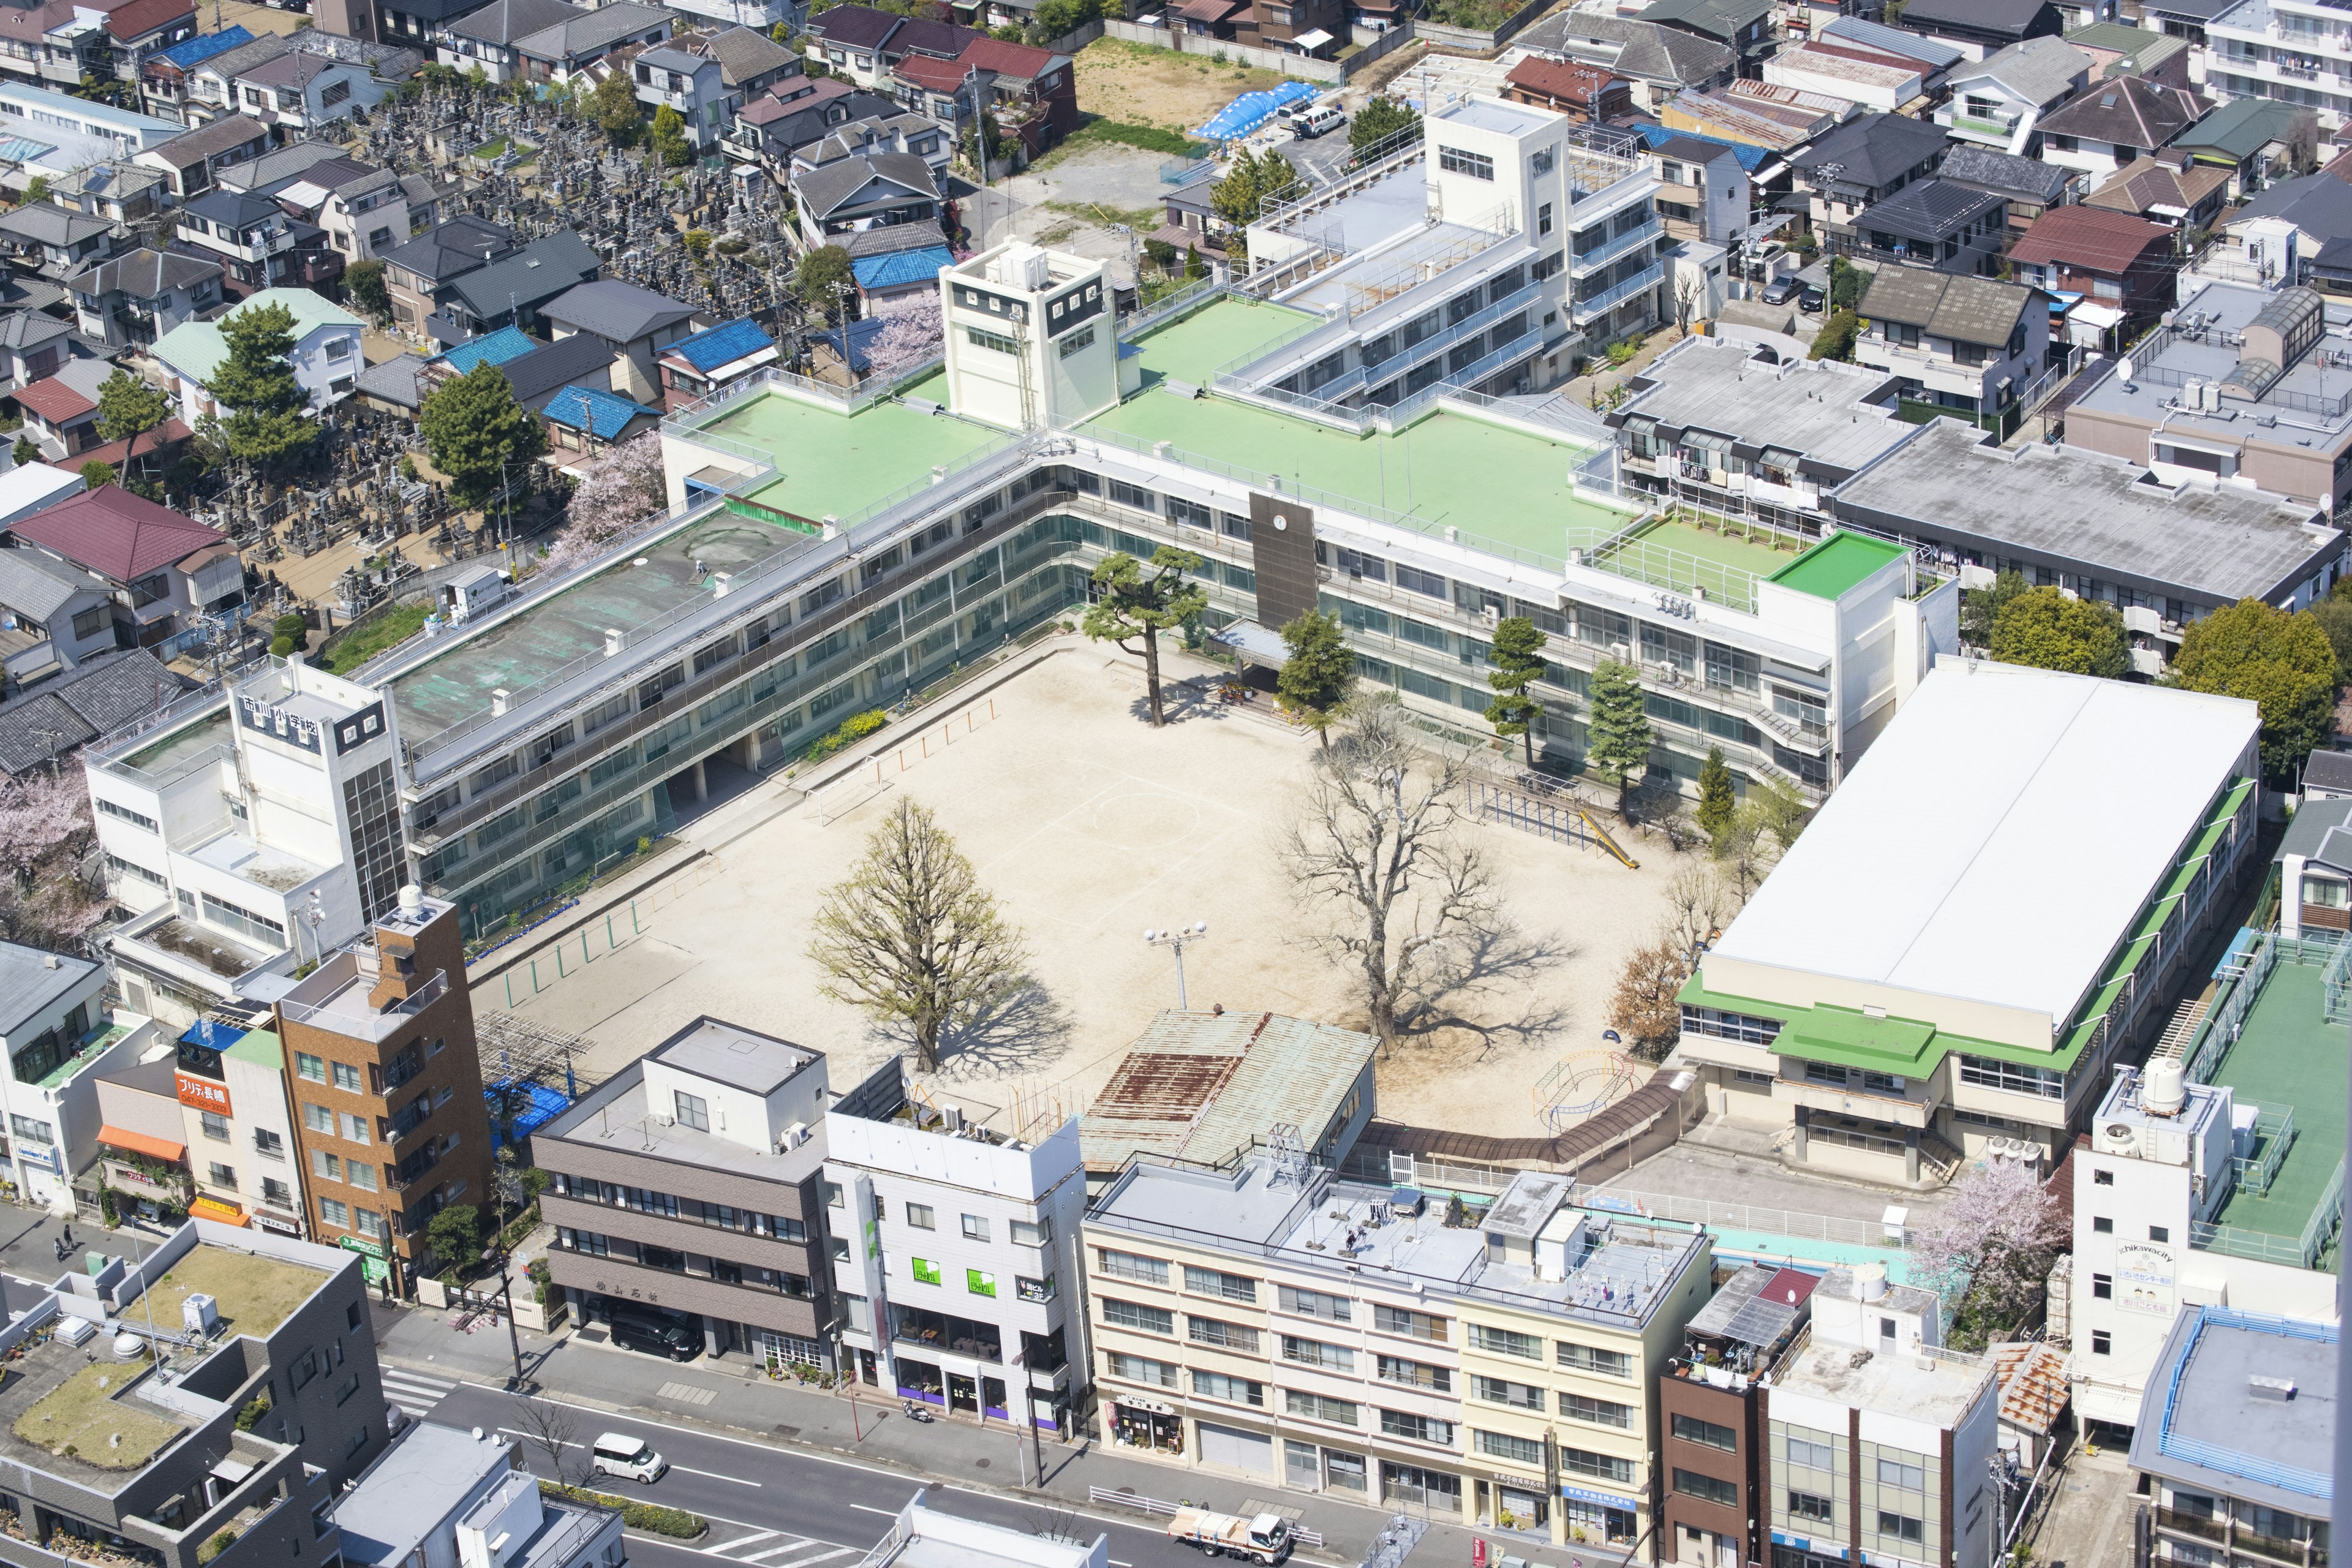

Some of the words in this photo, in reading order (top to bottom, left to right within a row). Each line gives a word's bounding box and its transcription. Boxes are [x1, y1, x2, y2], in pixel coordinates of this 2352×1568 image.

[244, 697, 316, 734] 市川小学校
[179, 1079, 225, 1103] プリティ長嶋
[181, 1095, 227, 1113] 047-321-3333
[2119, 1245, 2173, 1262] Ichikawacity
[2119, 1270, 2171, 1286] いきいきセンター市川
[1026, 1283, 1043, 1292] 当ビル
